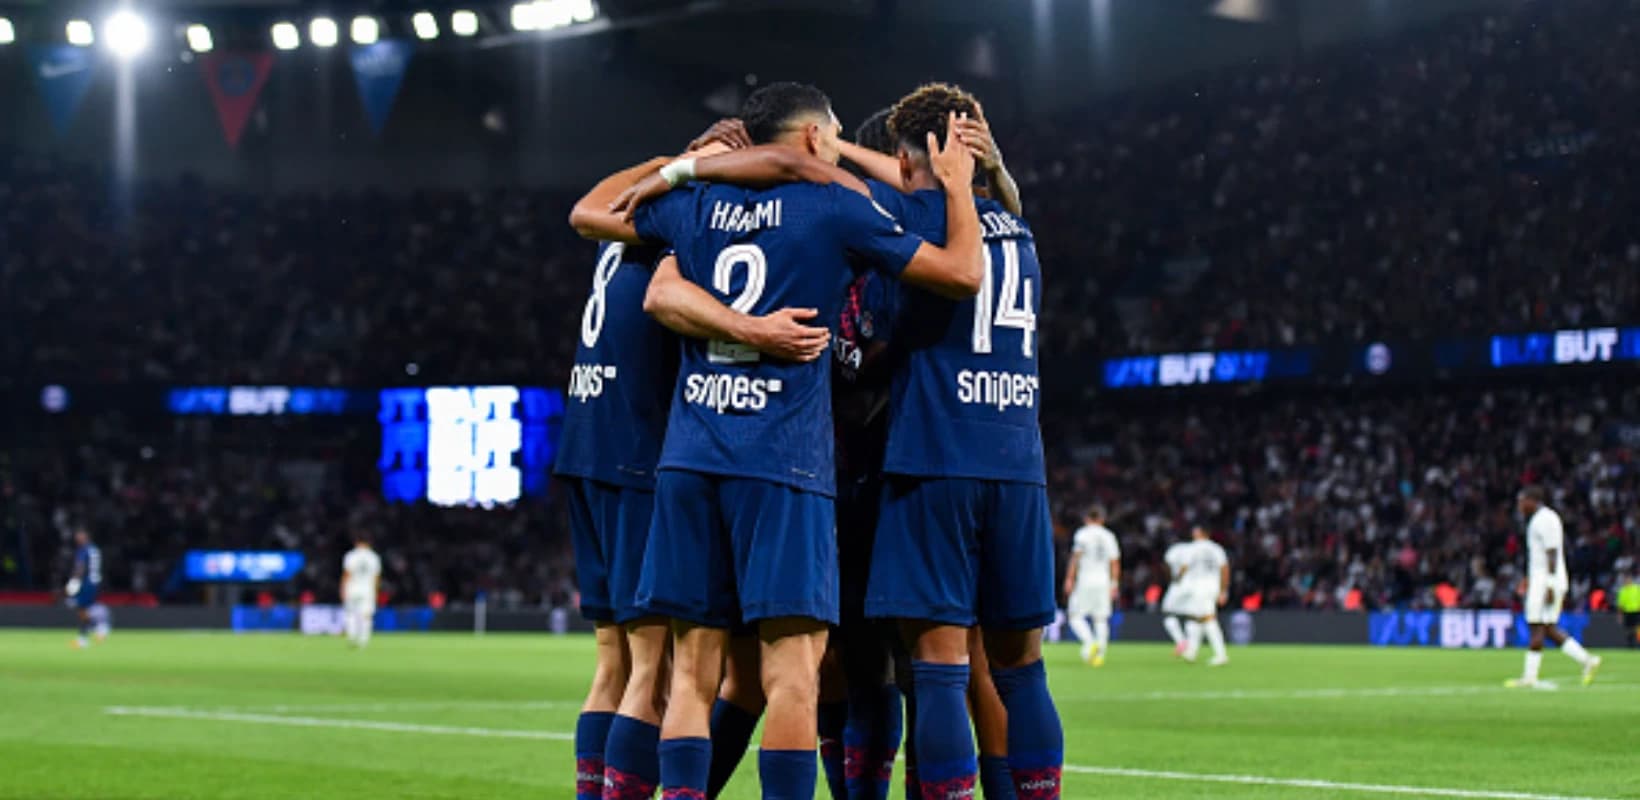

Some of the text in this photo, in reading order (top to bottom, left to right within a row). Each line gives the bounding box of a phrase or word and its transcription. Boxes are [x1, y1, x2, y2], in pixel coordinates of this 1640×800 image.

[582, 241, 625, 348] 8
[707, 243, 767, 363] 2
[972, 239, 1036, 358] 14
[1554, 327, 1618, 363] BUT
[957, 369, 1034, 412] snipes
[1160, 352, 1215, 386] BUT
[1440, 609, 1513, 648] BUT
